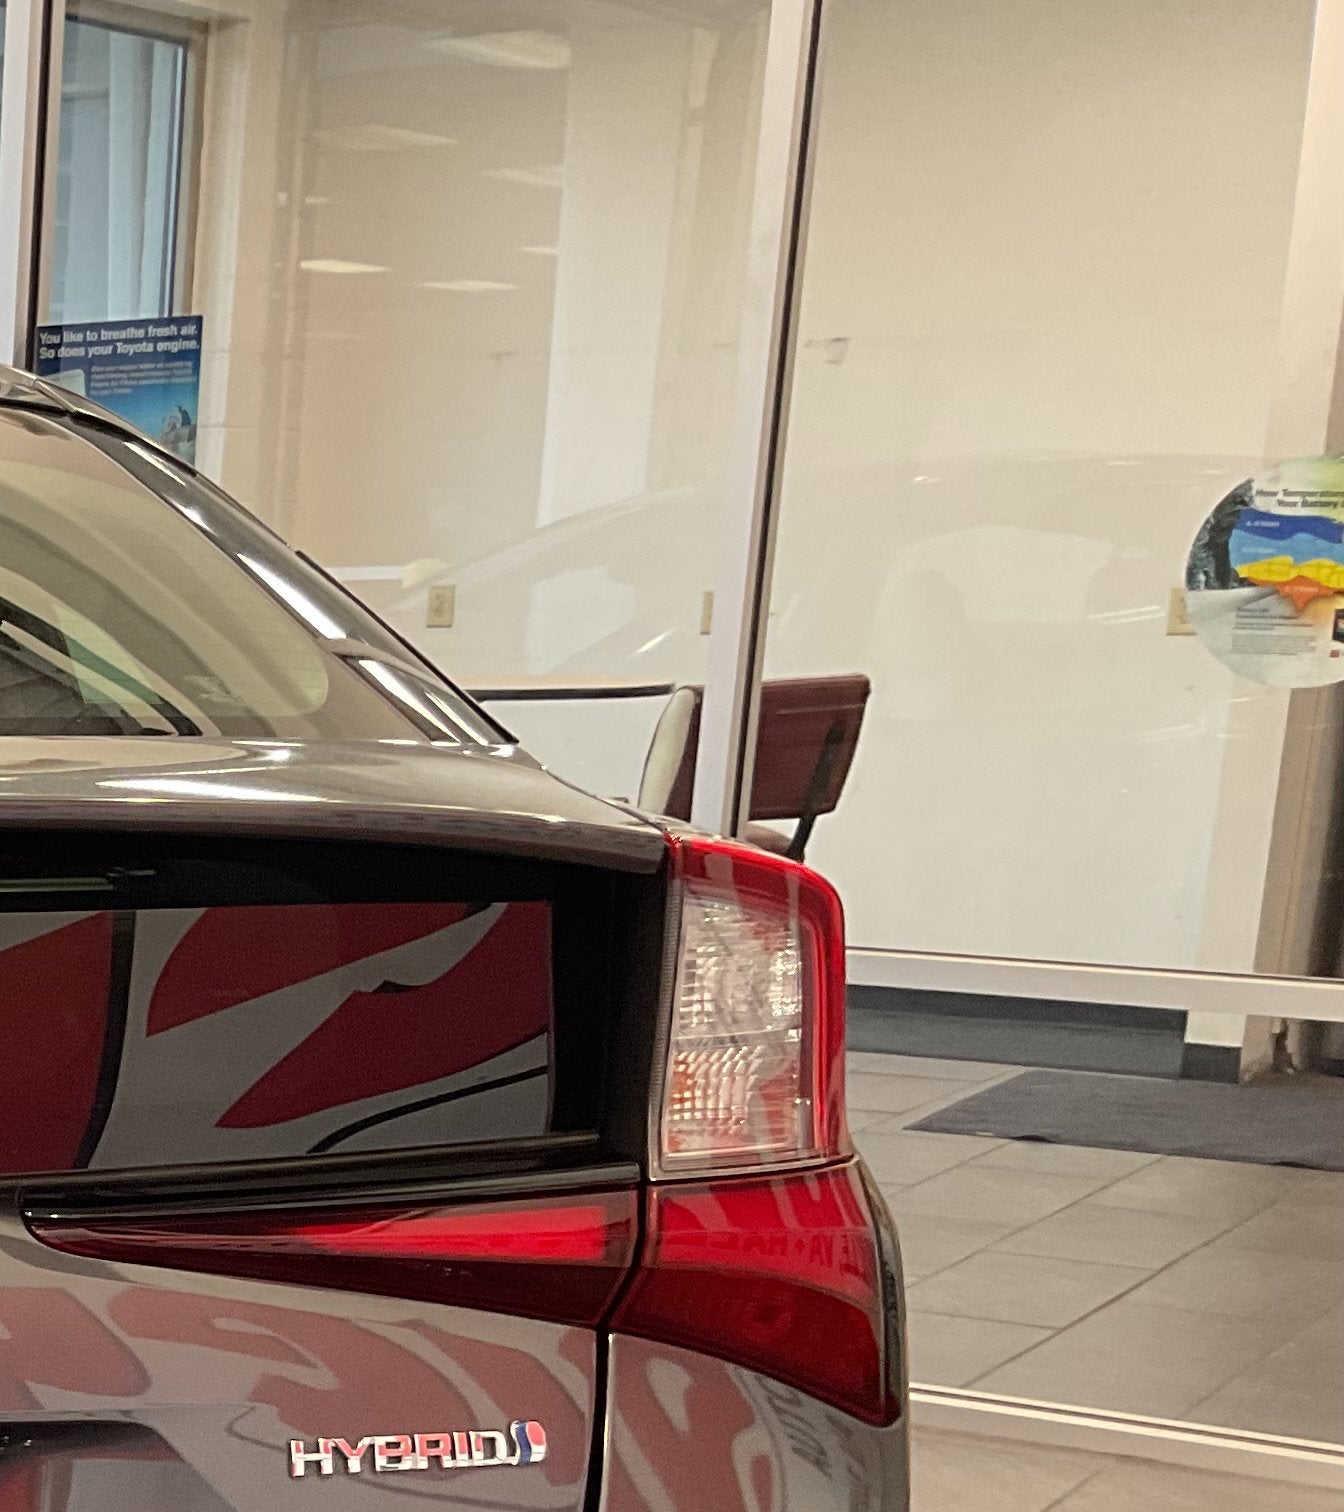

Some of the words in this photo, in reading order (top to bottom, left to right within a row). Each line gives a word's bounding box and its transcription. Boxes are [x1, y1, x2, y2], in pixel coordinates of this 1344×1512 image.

[39, 332, 60, 344] You
[63, 331, 84, 342] like
[86, 330, 98, 341] to
[101, 326, 145, 340] breathe
[148, 325, 178, 338] fresh
[39, 347, 55, 359] So
[58, 346, 86, 358] does
[87, 345, 113, 358] your
[115, 342, 153, 356] Toyota
[289, 1429, 514, 1478] HYBRID
